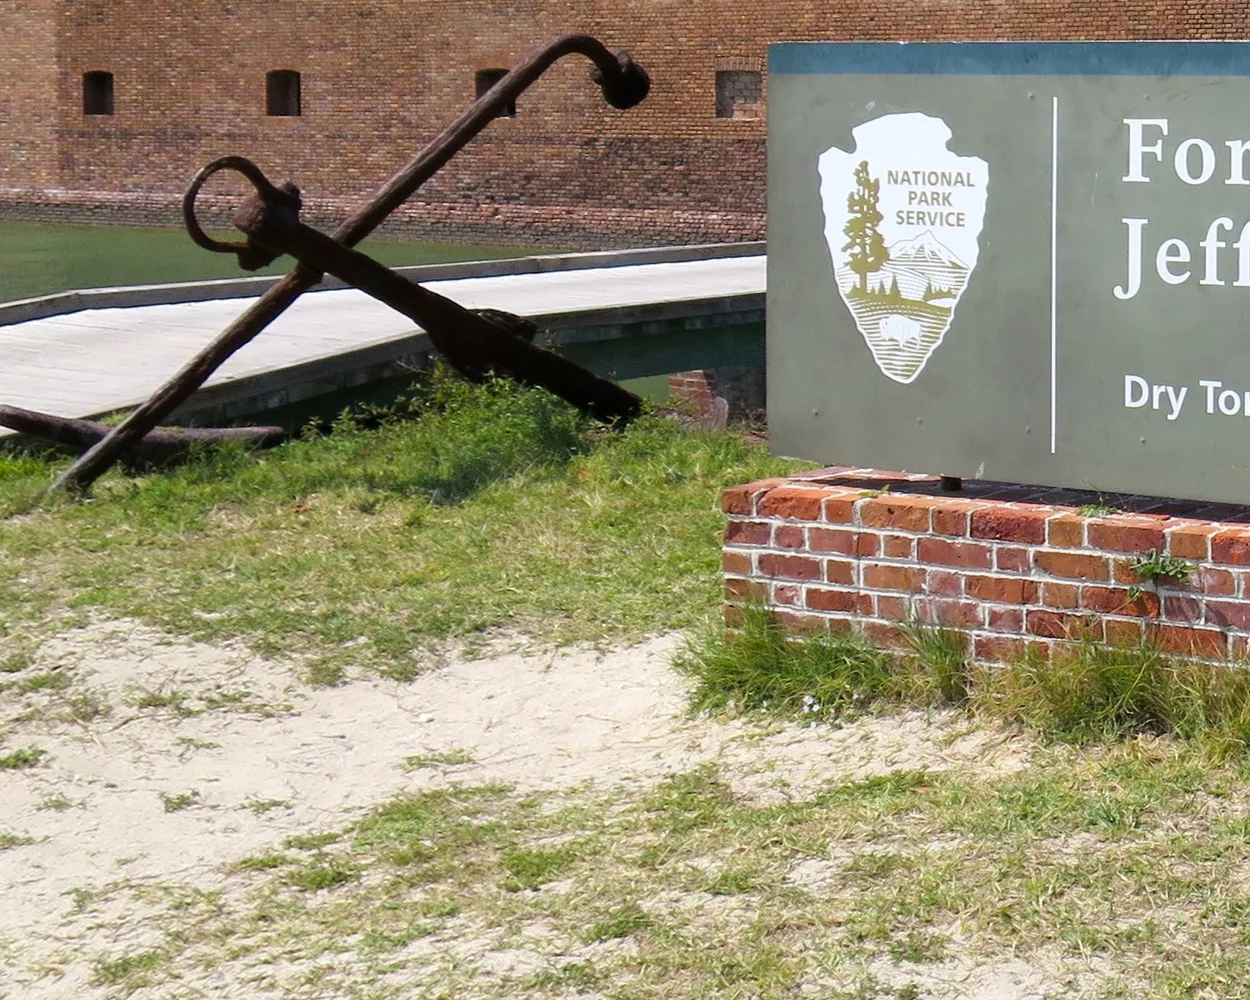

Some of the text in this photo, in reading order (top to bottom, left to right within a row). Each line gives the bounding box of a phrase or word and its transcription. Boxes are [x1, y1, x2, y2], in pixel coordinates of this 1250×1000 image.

[887, 170, 975, 188] NATIONAL
[908, 191, 953, 207] PARK
[896, 210, 966, 227] SERVICE
[1124, 374, 1188, 421] Dry
